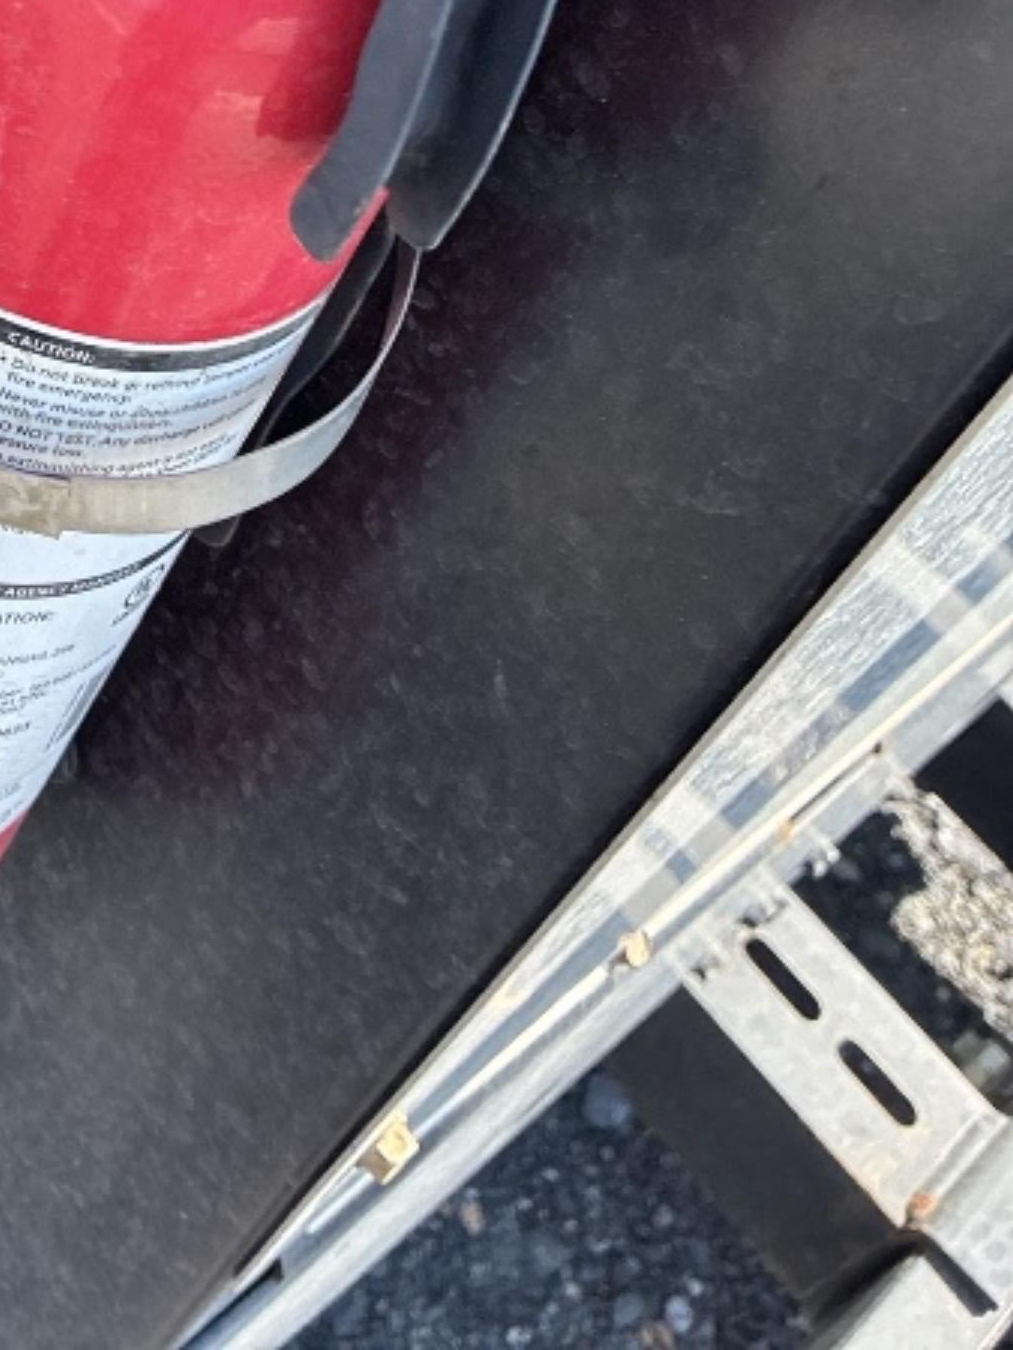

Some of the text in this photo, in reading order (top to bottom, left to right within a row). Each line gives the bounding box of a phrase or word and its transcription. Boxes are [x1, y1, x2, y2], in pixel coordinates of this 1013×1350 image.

[7, 331, 97, 363] CAUTION:
[7, 370, 36, 388] fire
[34, 410, 63, 426] fire
[16, 425, 53, 440] NOT
